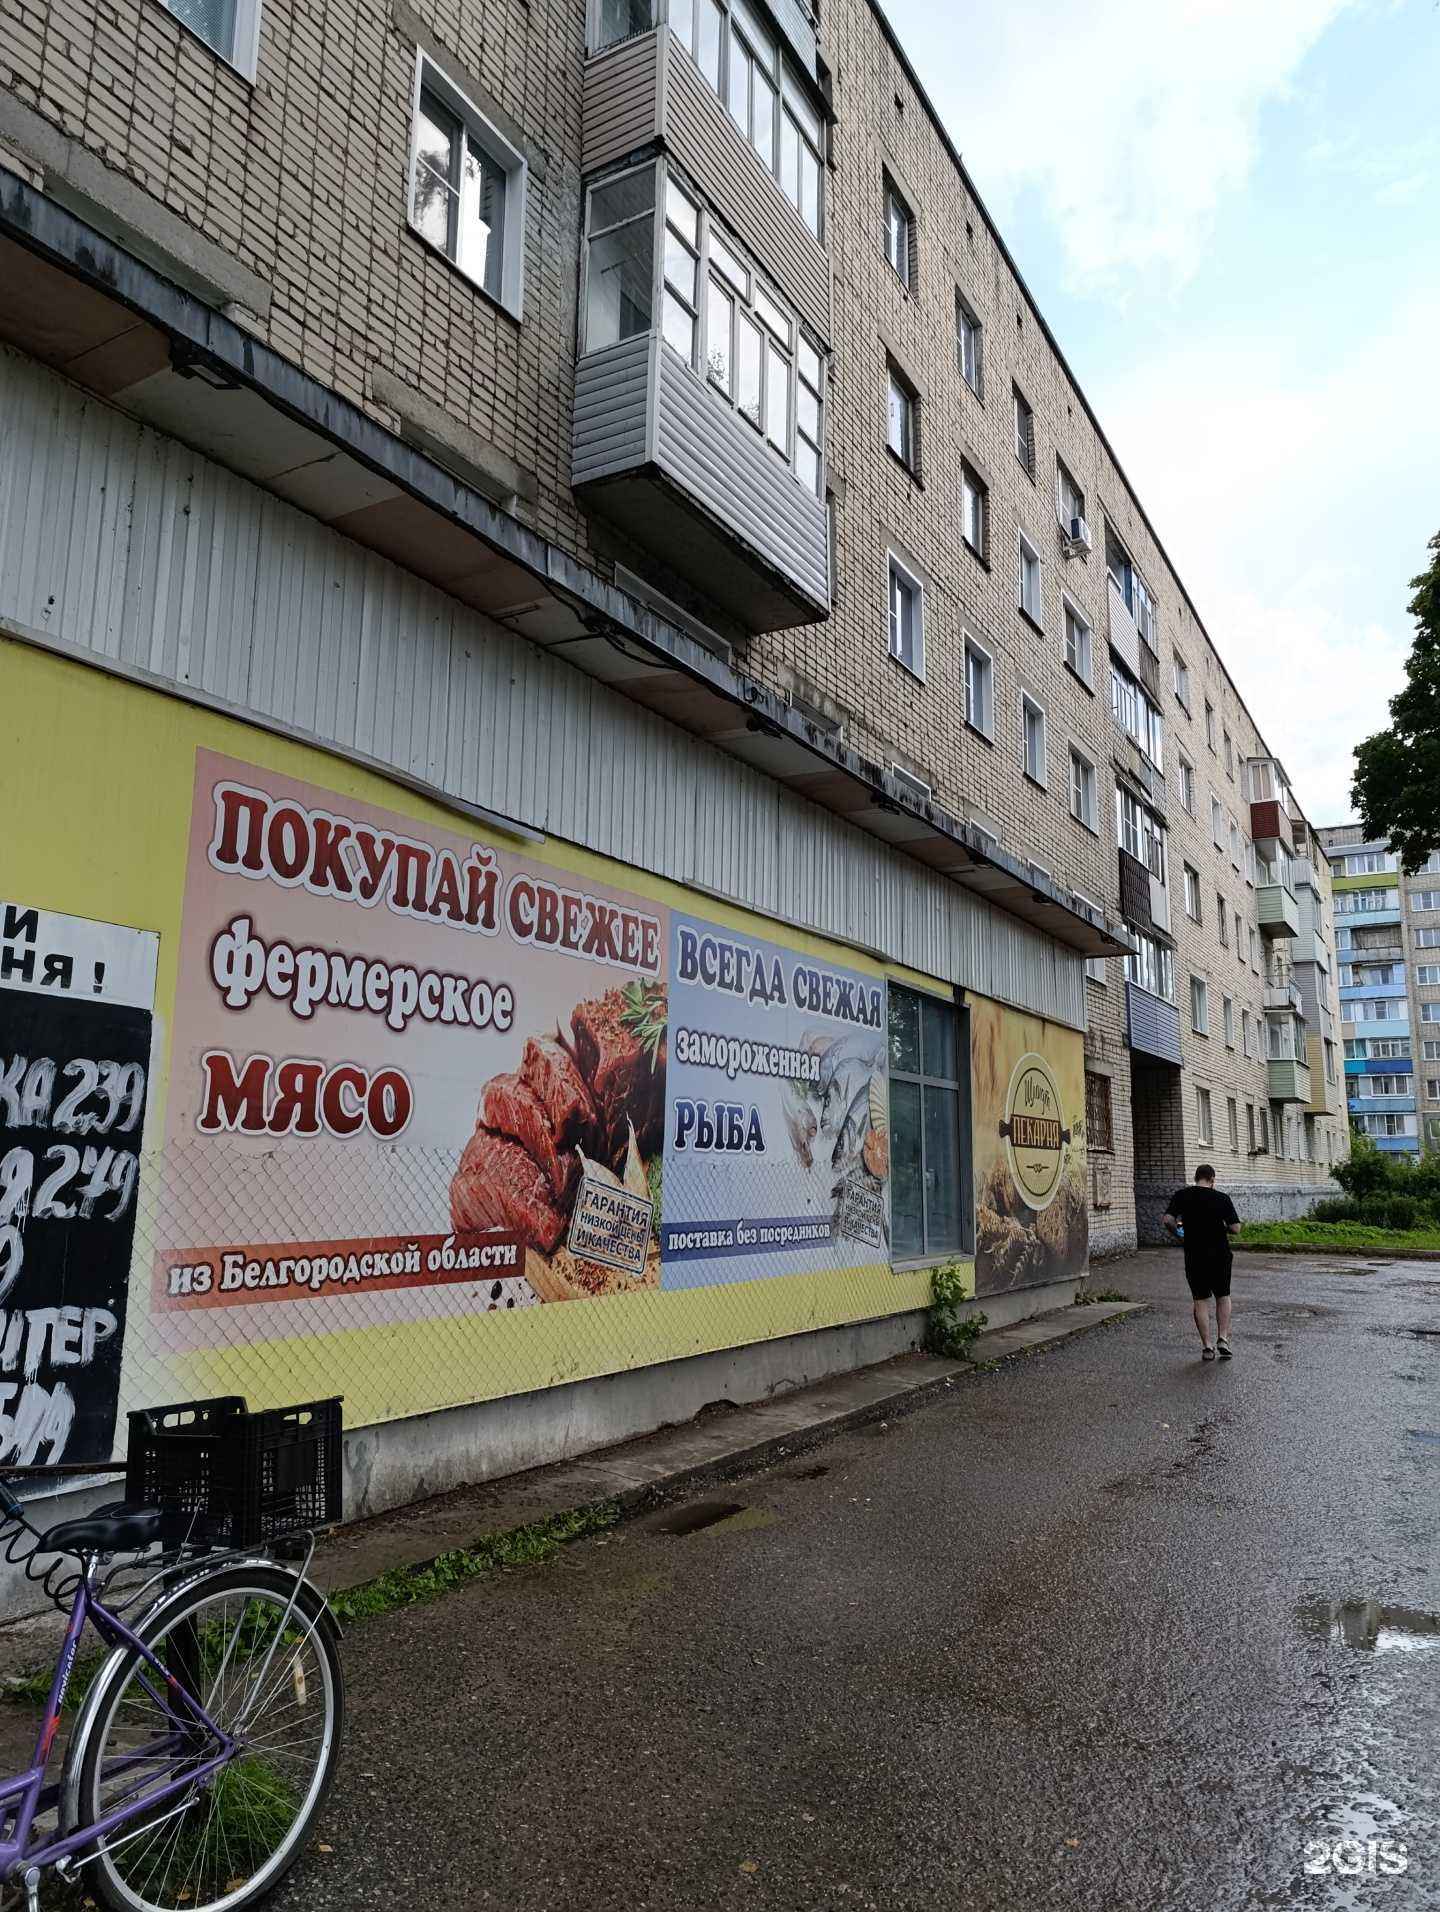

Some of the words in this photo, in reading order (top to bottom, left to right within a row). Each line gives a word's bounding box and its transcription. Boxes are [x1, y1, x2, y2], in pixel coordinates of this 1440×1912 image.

[211, 785, 500, 934] ПОКУПАЙ
[506, 876, 661, 974] СВЕЖЕЕ
[210, 915, 515, 1032] фермерское
[678, 928, 788, 1009] ВСЕГДА
[792, 965, 884, 1030] СВЕЖАЯ
[675, 1029, 822, 1082] замороженная
[674, 1099, 766, 1153] РЫБА
[1012, 1116, 1060, 1149] ПЕКАРНЯ
[584, 1190, 649, 1227] ГАРАНТИЯ
[668, 1229, 734, 1251] поставка
[736, 1220, 757, 1244] без
[759, 1223, 832, 1246] посредников
[168, 1265, 211, 1295] из
[219, 1243, 422, 1291] Белгородской
[427, 1234, 518, 1272] области
